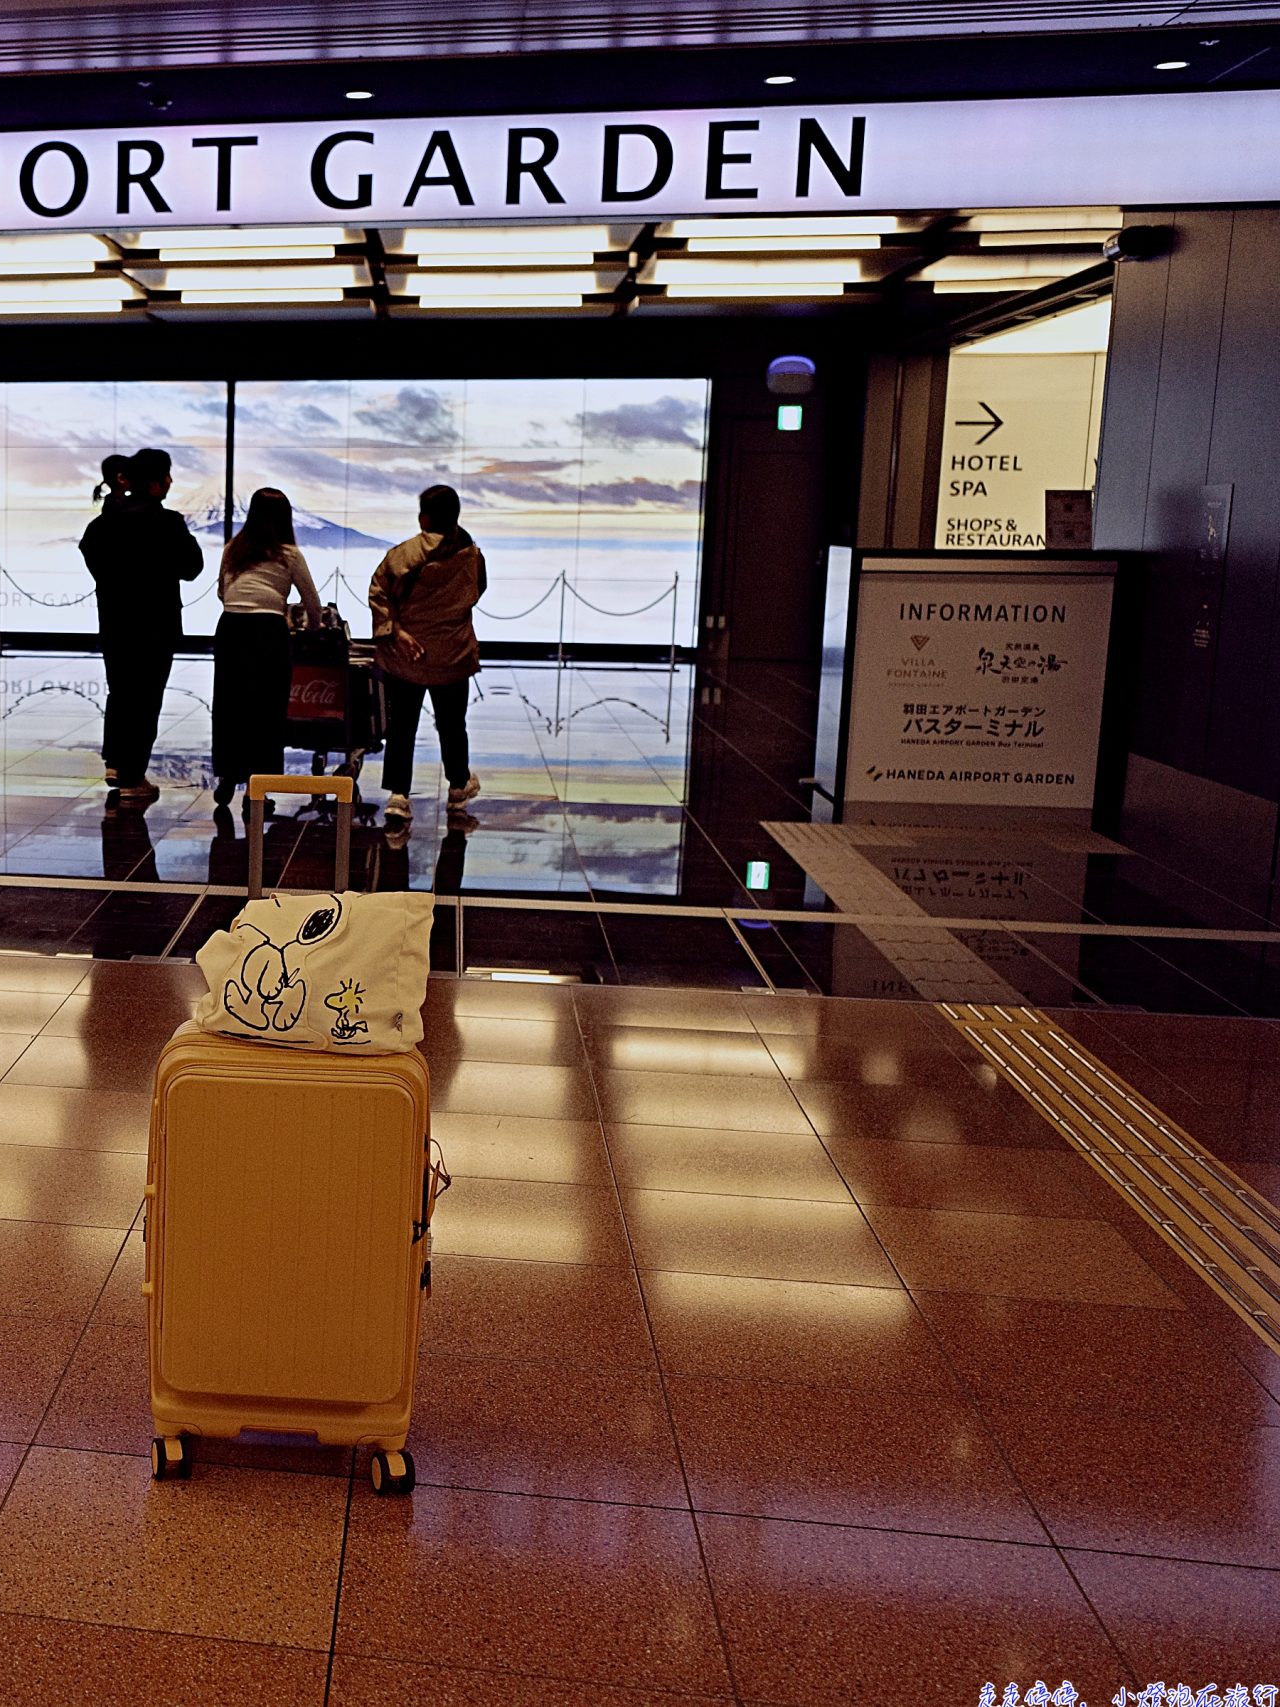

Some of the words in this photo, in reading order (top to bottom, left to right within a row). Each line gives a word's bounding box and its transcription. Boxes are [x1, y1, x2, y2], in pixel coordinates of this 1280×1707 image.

[308, 115, 866, 211] GARDEN
[951, 455, 1023, 471] HOTEL
[949, 480, 988, 497] SPA
[947, 517, 1002, 532] SHOPS
[1005, 518, 1018, 532] &
[899, 602, 1066, 623] INFORMATION
[901, 658, 935, 667] VILLA
[887, 669, 948, 679] FONTAINE
[903, 703, 1046, 717] 羽田エアポートガーデン
[903, 718, 1045, 738] バスターミナル
[901, 738, 930, 746] HANEDA
[886, 769, 945, 781] HANEDA
[948, 770, 1011, 783] AIRPORT
[1013, 772, 1076, 785] GARDEN
